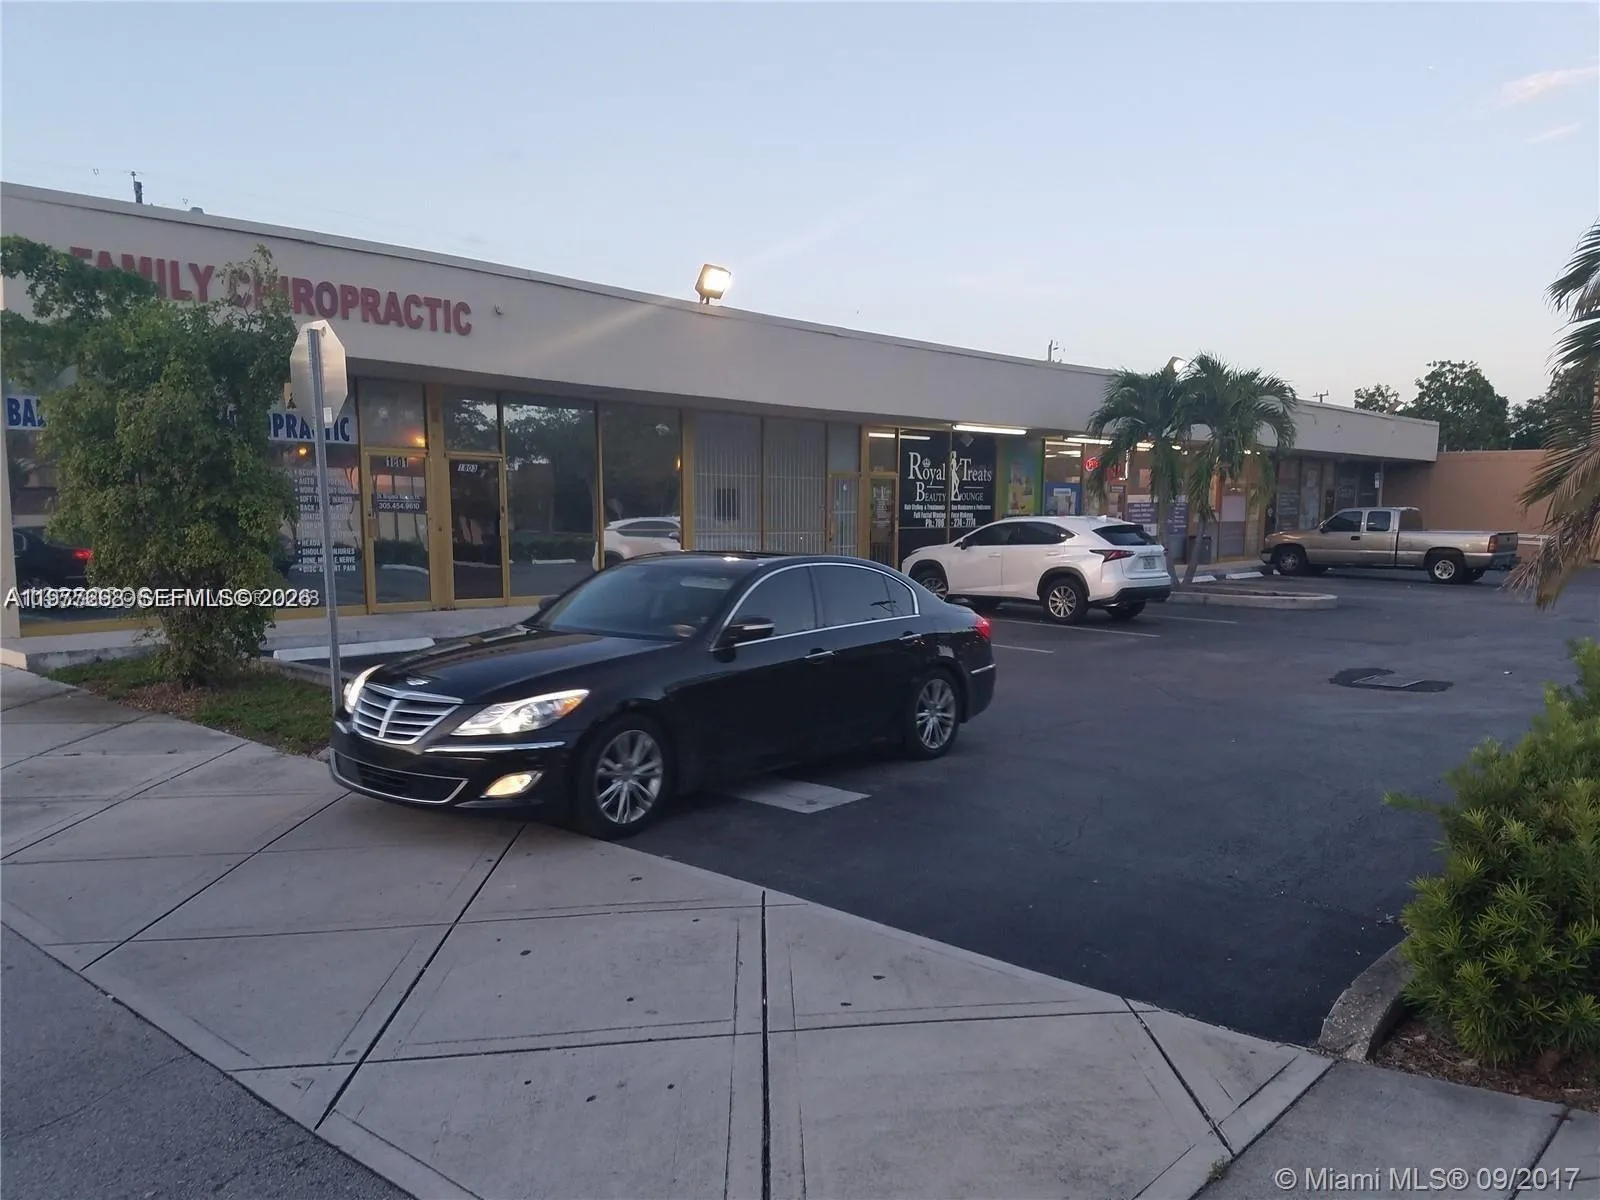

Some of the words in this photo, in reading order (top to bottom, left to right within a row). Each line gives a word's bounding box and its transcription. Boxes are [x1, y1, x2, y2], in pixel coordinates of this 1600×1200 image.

[908, 451, 946, 486] Royal
[960, 458, 992, 481] Treats
[915, 481, 947, 502] BEAUTY
